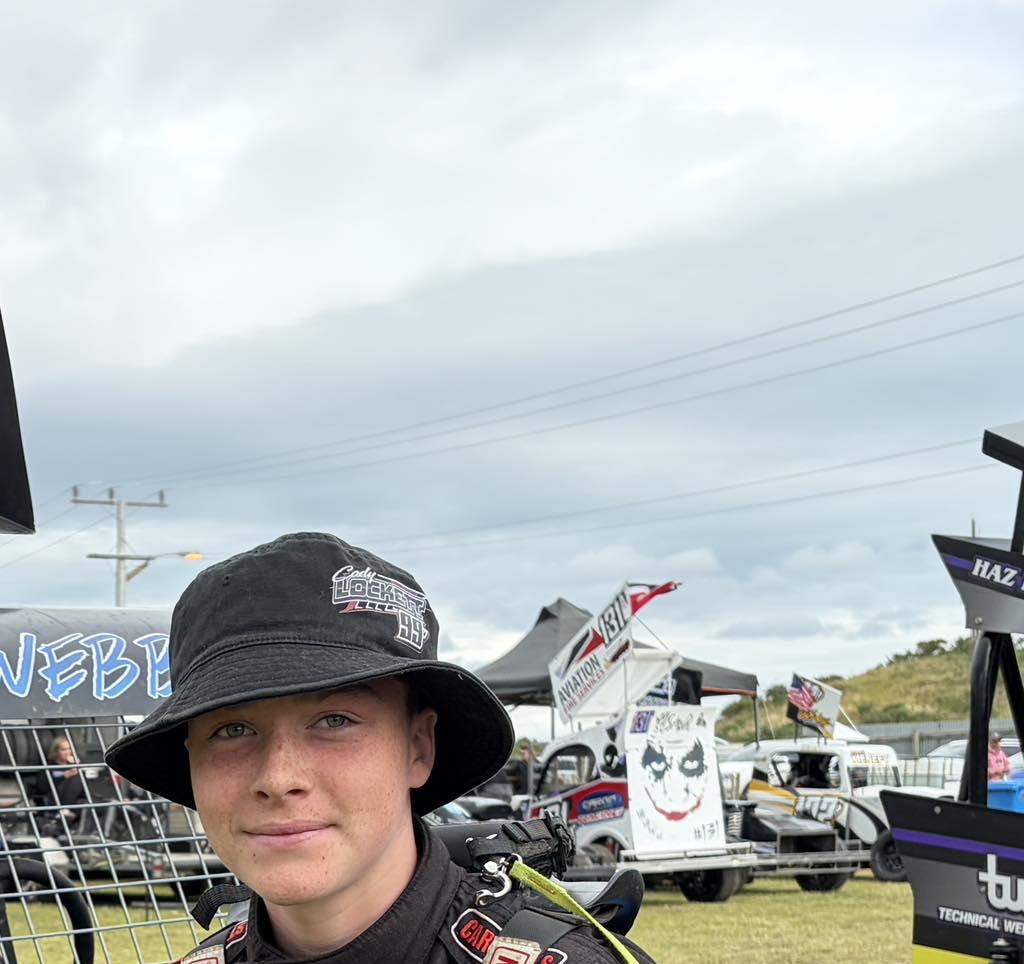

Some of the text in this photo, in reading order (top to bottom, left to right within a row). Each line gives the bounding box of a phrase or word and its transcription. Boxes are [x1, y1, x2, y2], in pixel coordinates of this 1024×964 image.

[332, 565, 376, 582] Cody
[972, 558, 1018, 587] HAZ
[557, 654, 602, 705] AVIATION
[938, 906, 1001, 931] TECHNICAL
